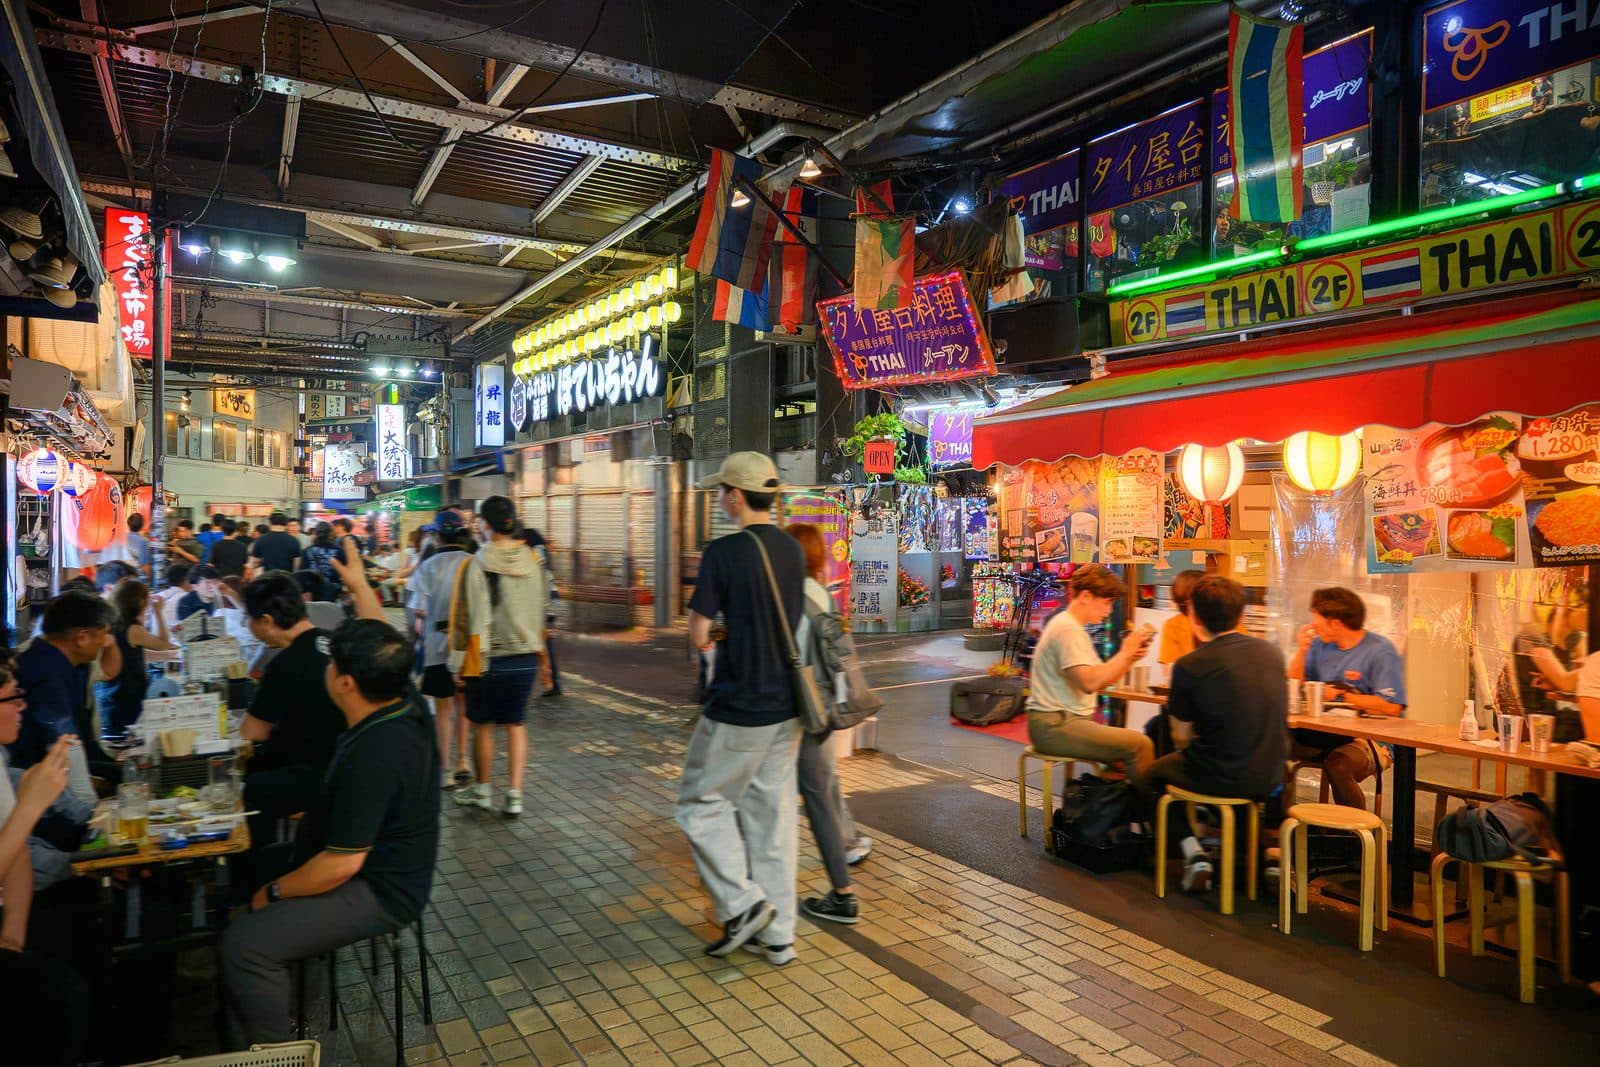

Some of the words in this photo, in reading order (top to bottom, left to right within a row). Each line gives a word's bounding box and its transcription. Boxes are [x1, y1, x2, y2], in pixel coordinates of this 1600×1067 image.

[1518, 0, 1600, 48] TH
[1092, 120, 1203, 194] タイ屋台
[1028, 178, 1079, 216] THAI
[1429, 221, 1552, 292] THAI
[1211, 274, 1296, 329] THAI
[1312, 274, 1348, 305] 2F
[1130, 311, 1157, 336] 2F
[557, 334, 659, 416] ほていちゃん
[868, 351, 906, 371] THAI
[924, 344, 969, 367] メーアン
[484, 384, 502, 426] 昇龍
[383, 429, 402, 478] 大統領
[869, 450, 890, 467] OPEN
